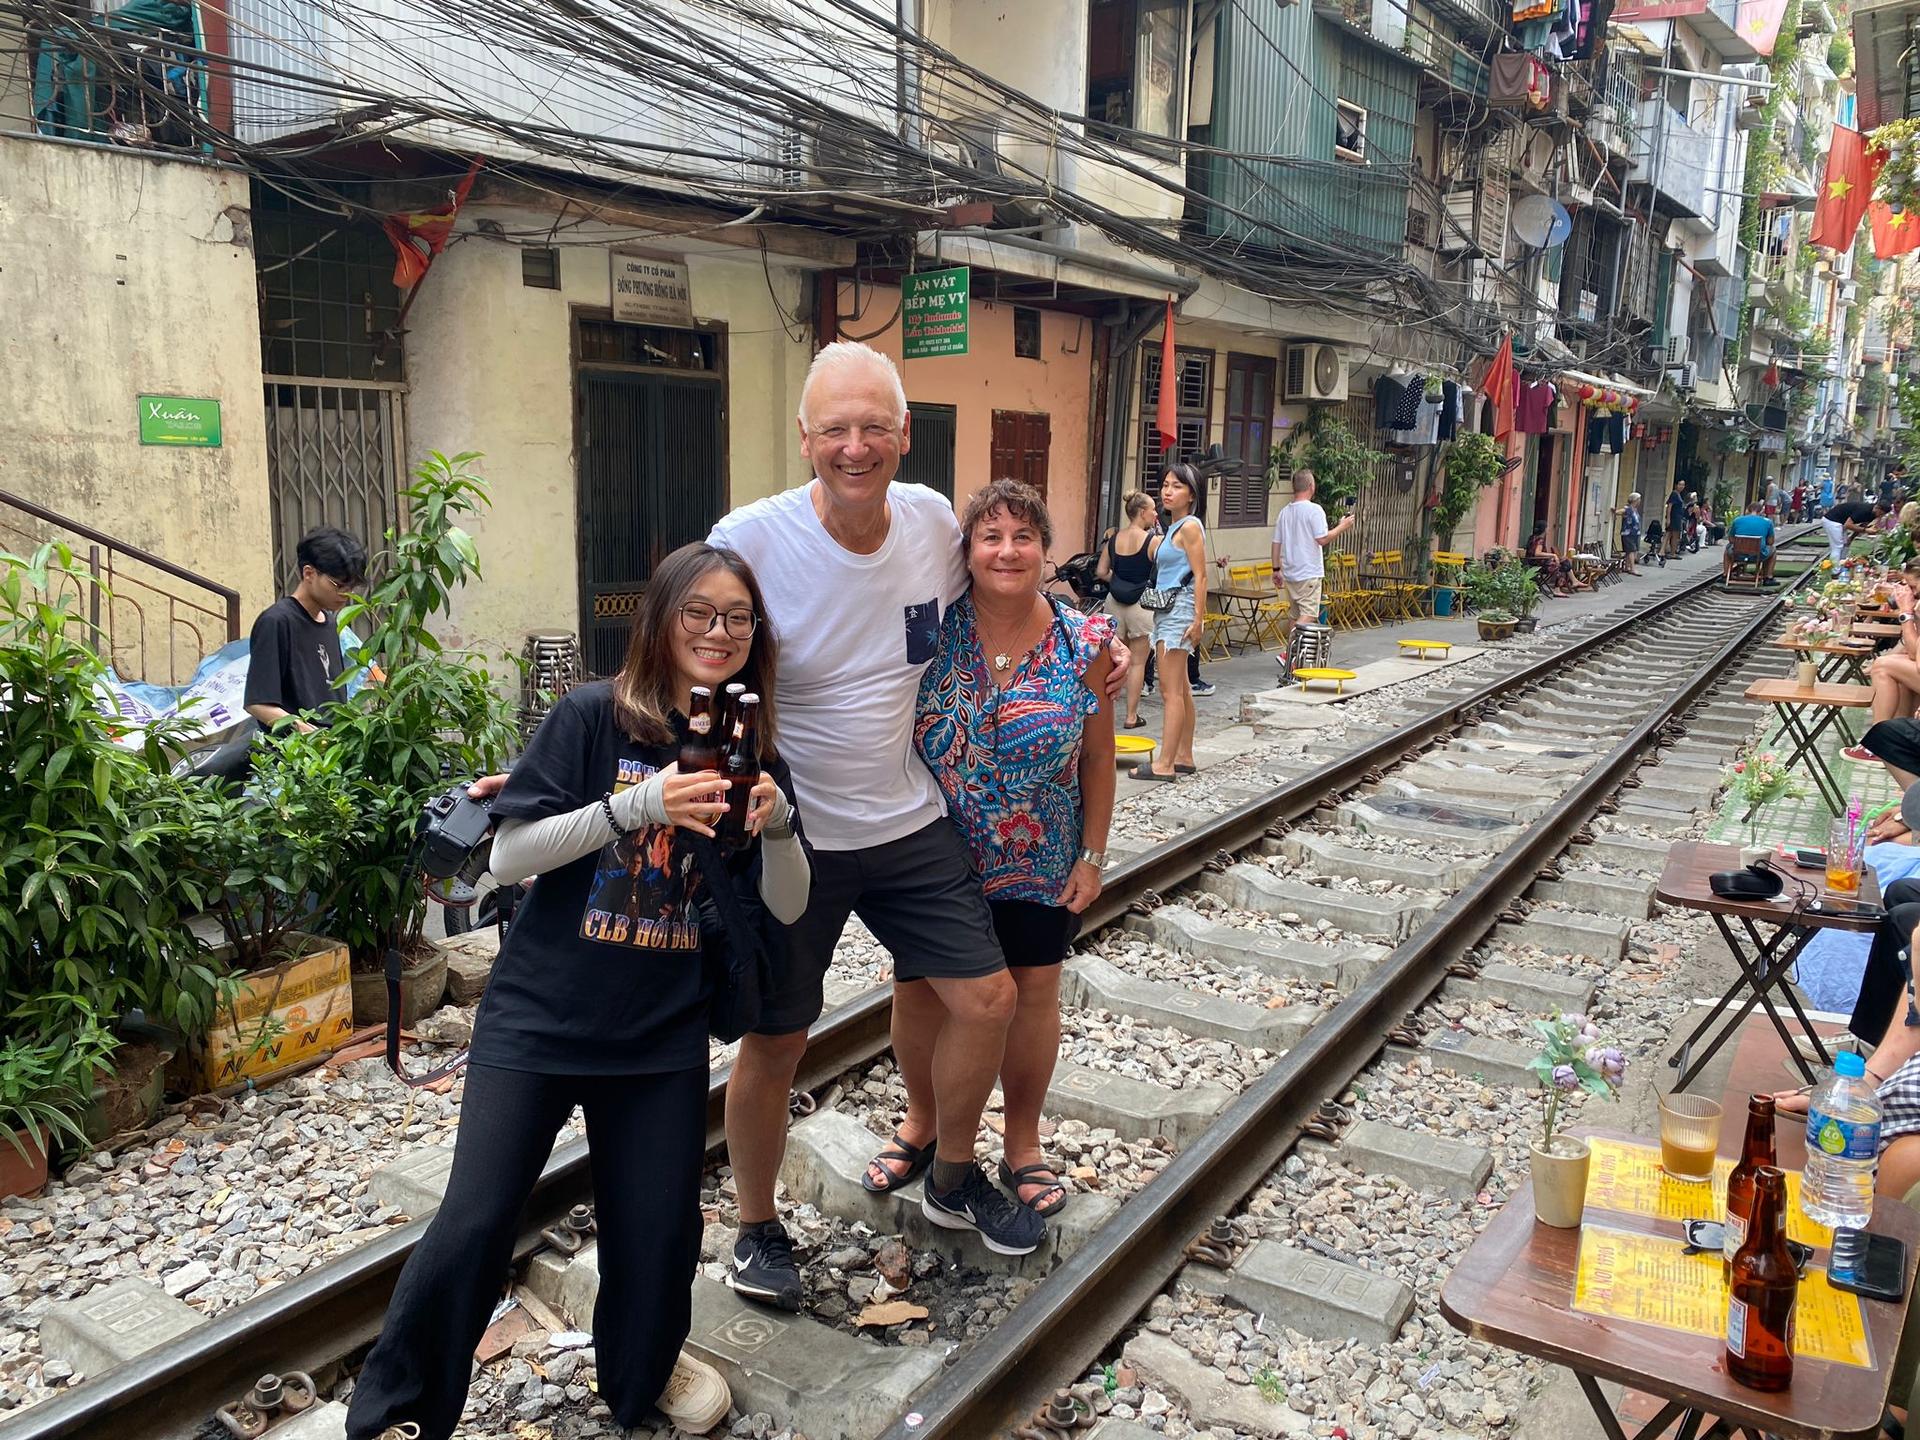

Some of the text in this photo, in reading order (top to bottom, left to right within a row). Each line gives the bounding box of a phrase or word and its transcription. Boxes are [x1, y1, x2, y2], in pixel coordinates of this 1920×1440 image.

[644, 266, 650, 275] TY
[934, 275, 956, 290] VẶT
[904, 292, 966, 310] BẾP MẸ VY
[149, 402, 200, 420] Xuân
[584, 908, 630, 942] CLB
